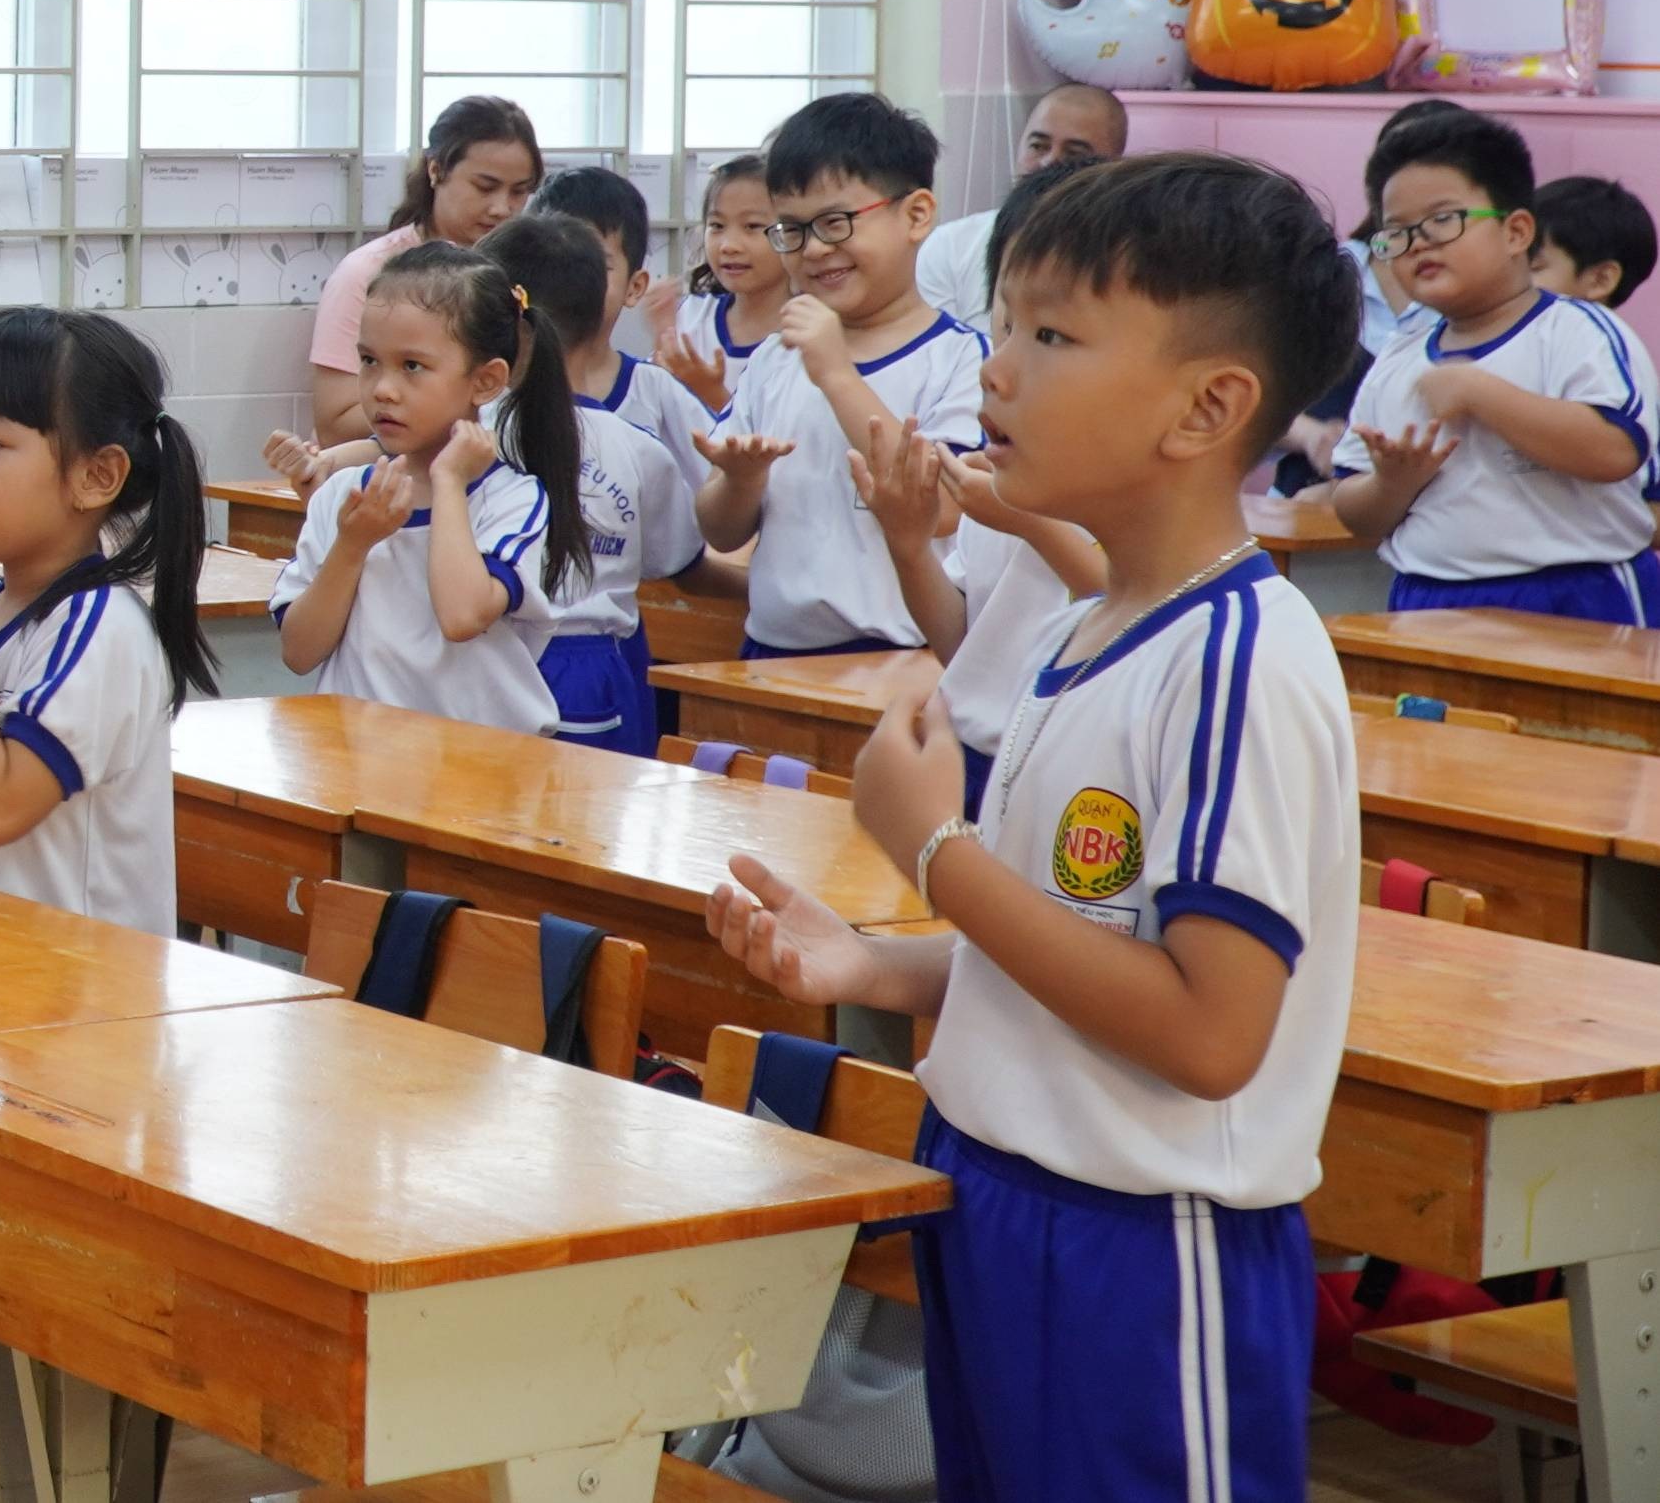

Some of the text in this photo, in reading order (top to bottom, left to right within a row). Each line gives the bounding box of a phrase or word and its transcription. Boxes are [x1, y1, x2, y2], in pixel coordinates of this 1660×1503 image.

[607, 483, 636, 523] HỌC
[1078, 798, 1114, 819] QUẬN
[1063, 826, 1127, 865] NBK
